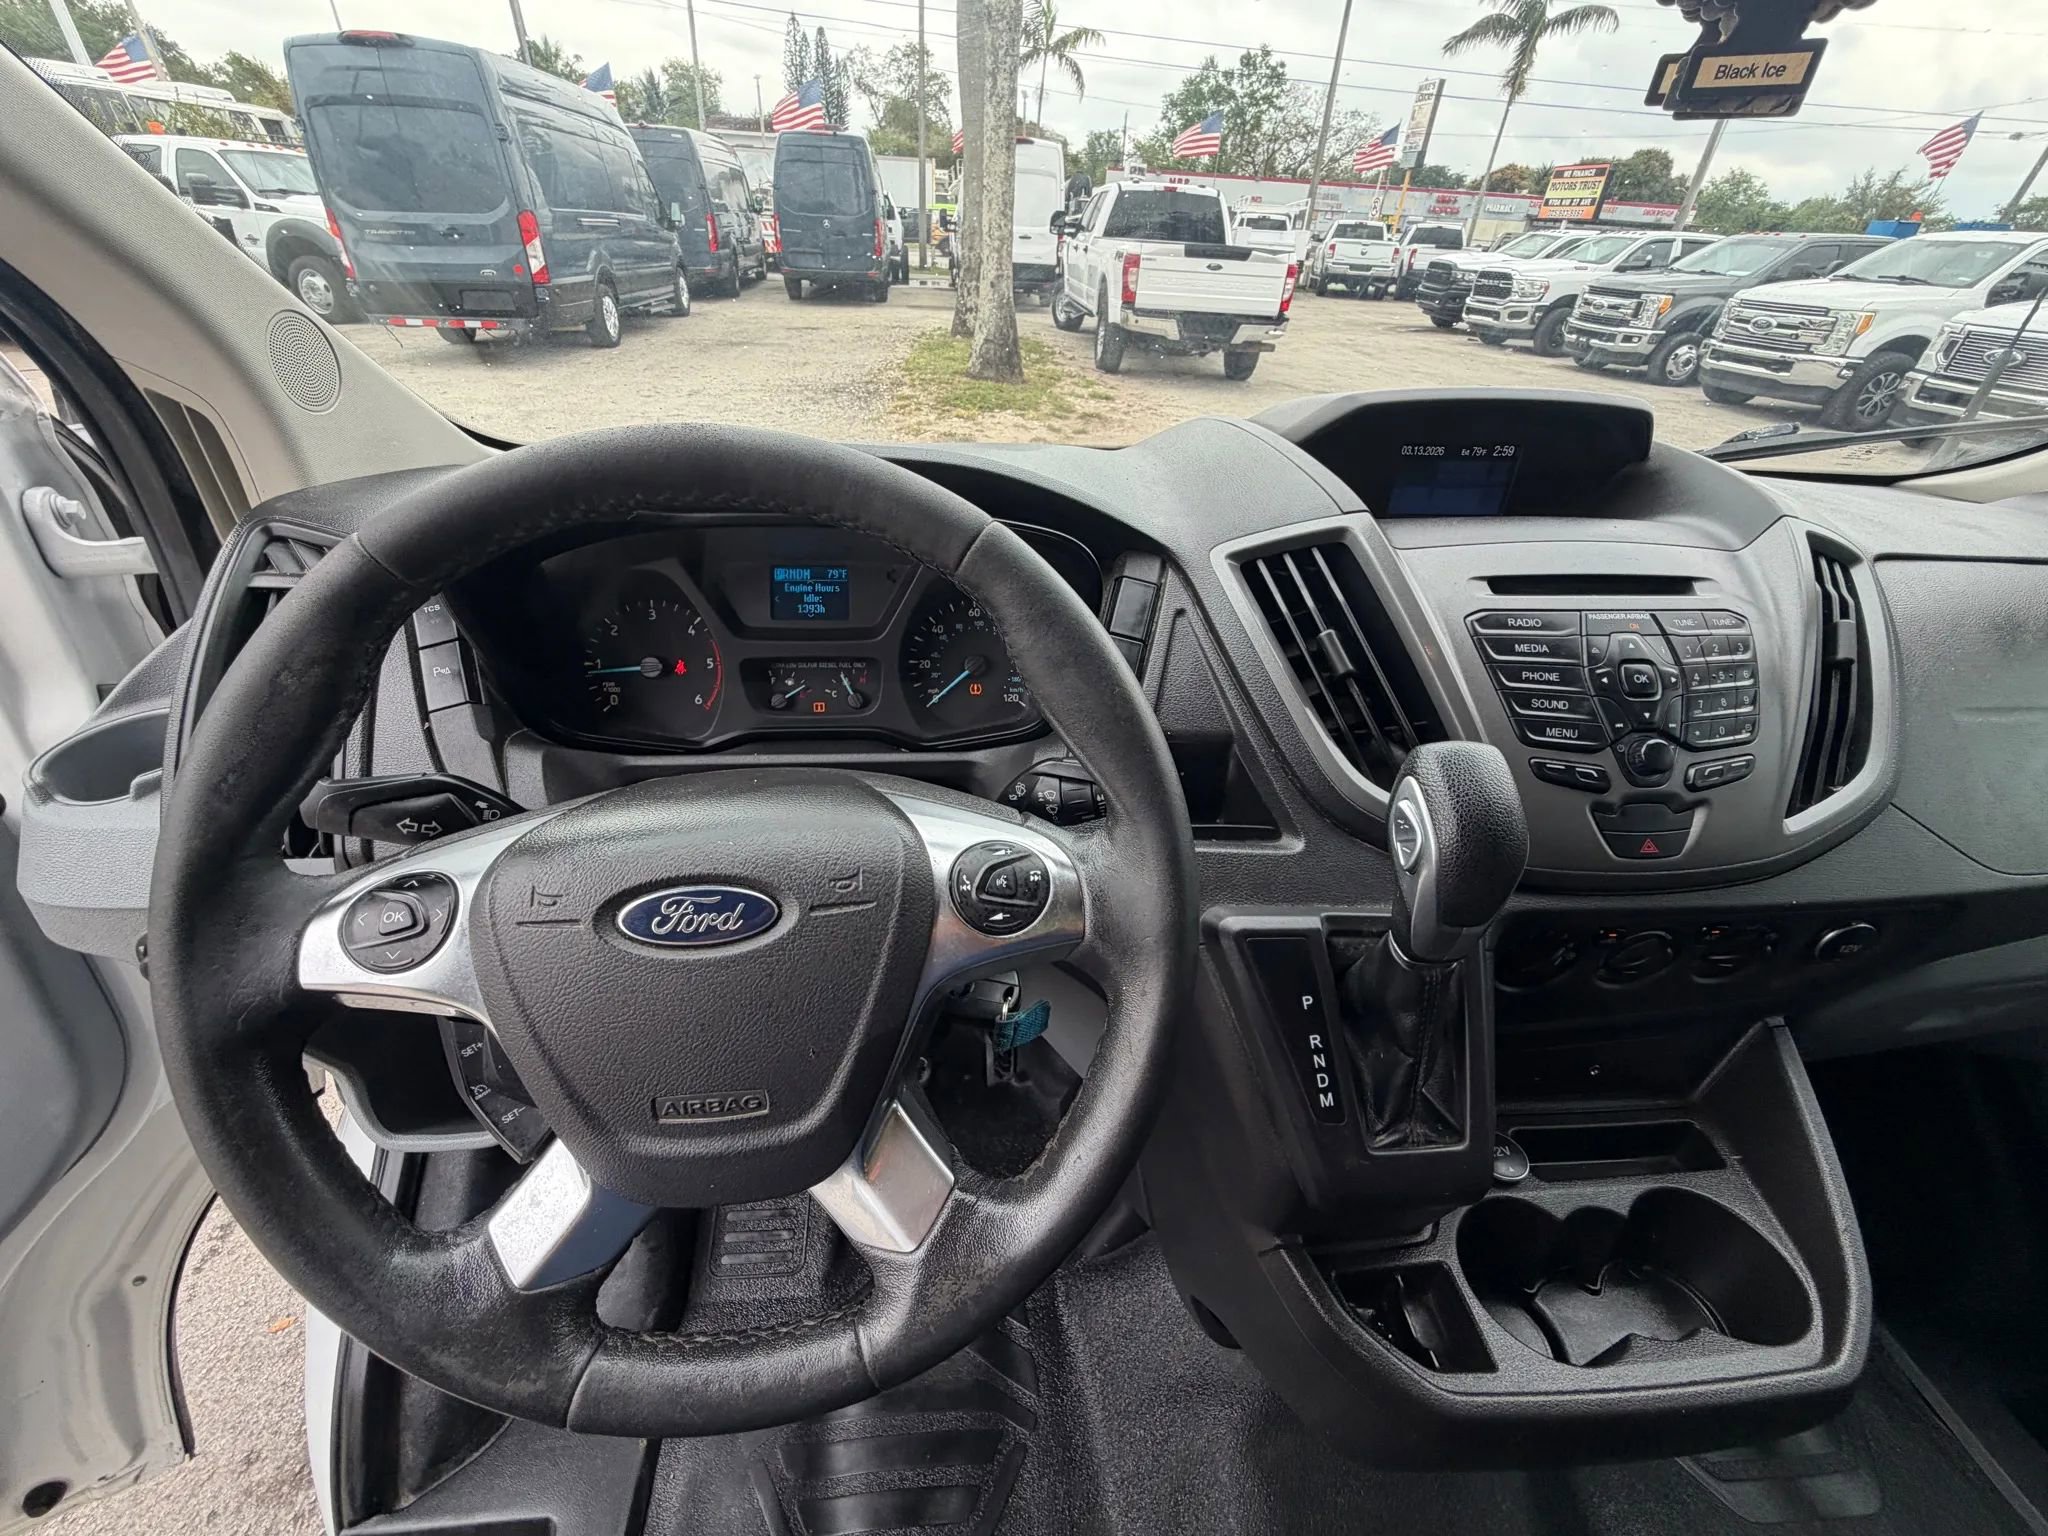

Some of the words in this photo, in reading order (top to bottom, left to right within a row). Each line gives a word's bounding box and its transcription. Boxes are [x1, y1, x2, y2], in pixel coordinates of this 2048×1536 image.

[1713, 63, 1759, 80] Black
[1761, 62, 1787, 78] Ice
[1549, 181, 1579, 191] MOTORS
[1579, 180, 1602, 190] TRUST
[1401, 445, 1445, 456] 03.13.2026
[1493, 445, 1516, 457] 2:59
[784, 582, 813, 593] Engine
[815, 582, 841, 593] Hours
[423, 604, 441, 614] TCS
[648, 609, 657, 620] 3
[797, 604, 826, 614] 1393h
[968, 608, 981, 617] 60
[1587, 612, 1627, 620] PASSENGER
[1507, 617, 1542, 628] RADIO
[610, 624, 619, 636] 2
[687, 624, 696, 636] 4
[931, 625, 944, 634] 40
[1514, 643, 1550, 653] MEDIA
[1712, 643, 1720, 652] 2
[1737, 642, 1744, 651] 3
[706, 658, 714, 669] 5
[919, 660, 931, 669] 20
[1522, 671, 1561, 682] PHONE
[1633, 673, 1650, 684] OK
[1693, 672, 1700, 681] 4
[1718, 671, 1725, 680] 5
[1743, 669, 1750, 679] 6
[694, 694, 703, 705] 6
[831, 690, 838, 698] C
[1003, 694, 1019, 703] 120
[1743, 695, 1750, 704] 9
[609, 694, 619, 706] 0
[1531, 698, 1569, 710] SOUND
[1697, 699, 1704, 709] 7
[1720, 697, 1728, 707] 8
[1545, 727, 1579, 739] MENU
[1719, 726, 1726, 735] 0
[383, 910, 406, 924] OK
[651, 895, 746, 935] Ford
[1301, 995, 1314, 1011] P
[1309, 1034, 1323, 1050] R
[460, 1041, 484, 1058] SET+
[1313, 1053, 1327, 1069] N
[1316, 1073, 1329, 1089] D
[661, 1094, 762, 1117] AIRBAG
[1319, 1091, 1335, 1109] M
[501, 1105, 527, 1124] SET-
